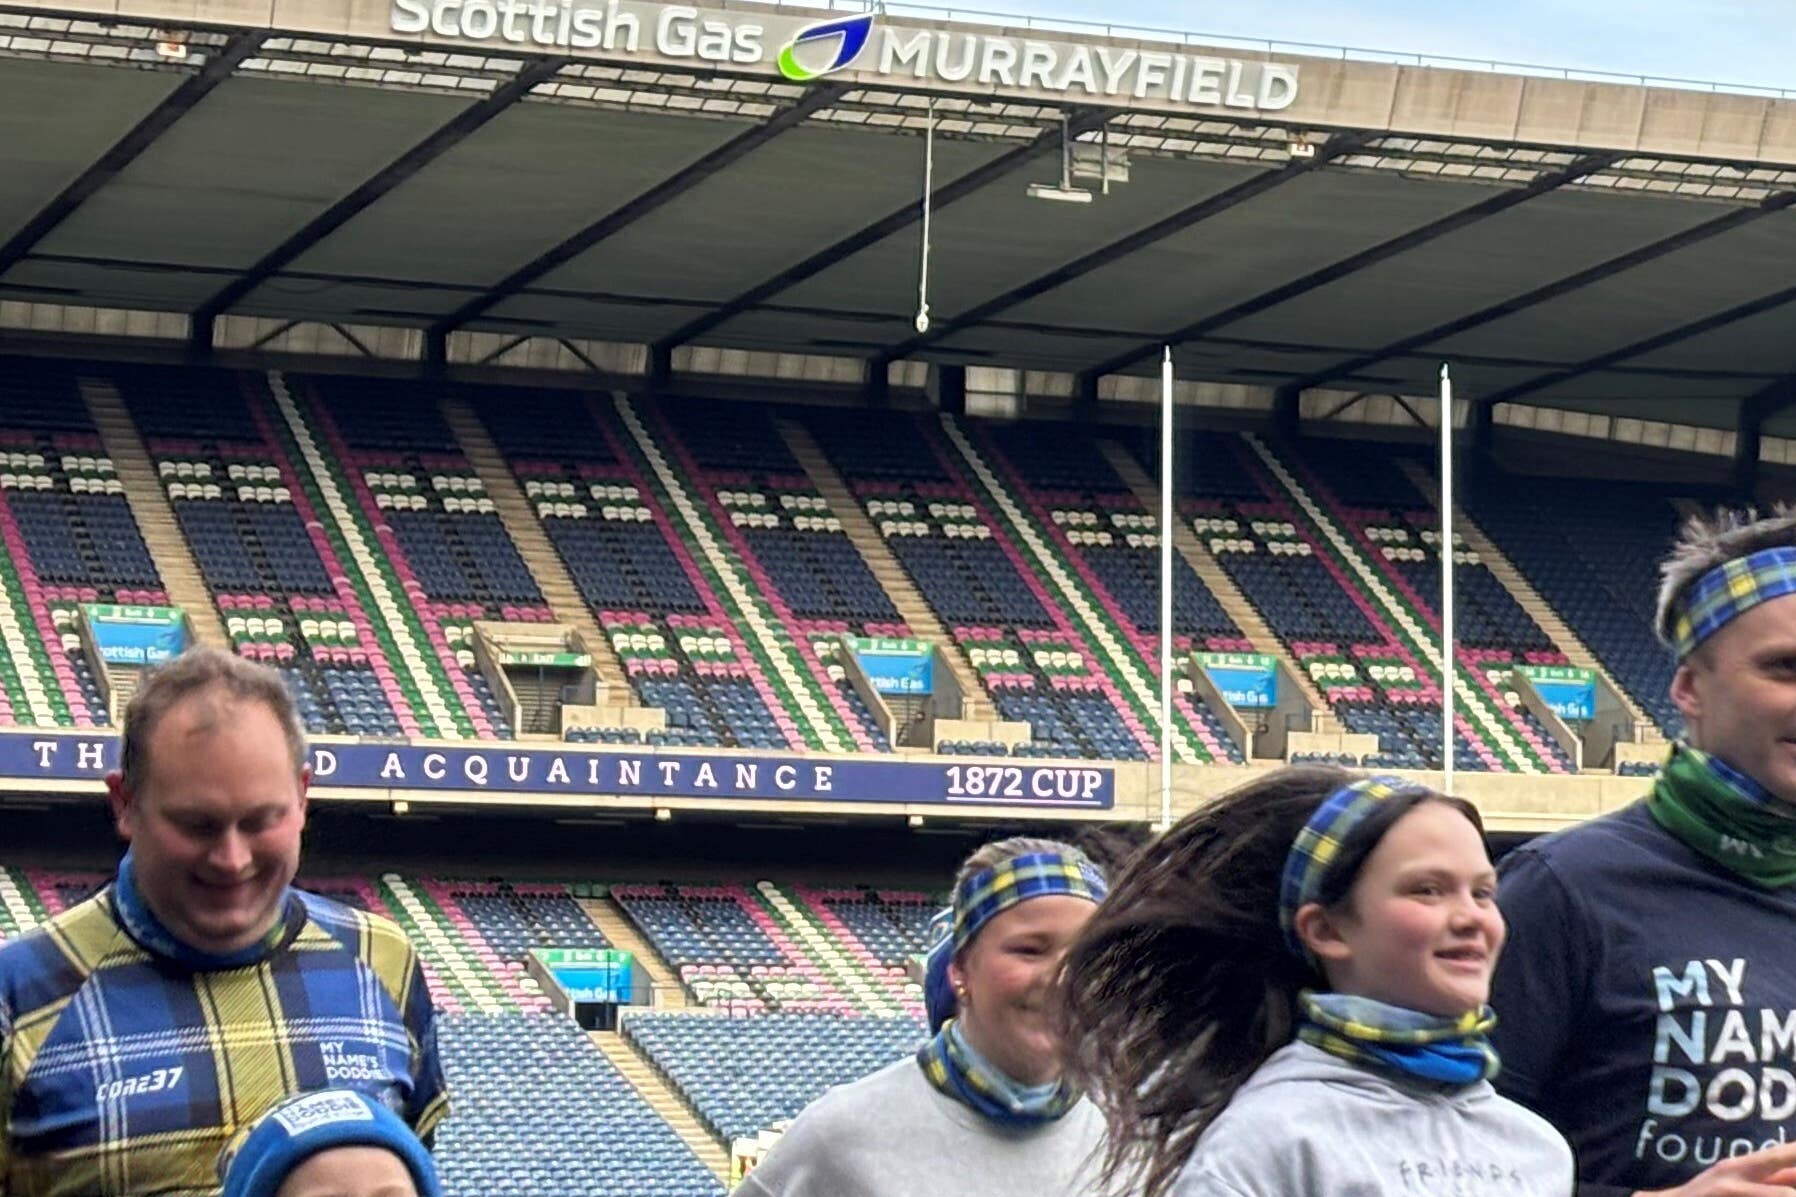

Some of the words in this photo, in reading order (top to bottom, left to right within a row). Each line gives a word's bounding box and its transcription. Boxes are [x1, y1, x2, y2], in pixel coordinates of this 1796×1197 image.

[390, 0, 639, 50] Scottish
[656, 7, 764, 62] Gas
[878, 28, 1299, 110] MURRAYFIELD
[34, 741, 104, 769] TH
[380, 752, 834, 792] ACQUAINTANCE
[946, 766, 1023, 796] 1872
[1032, 768, 1102, 798] CUP
[1652, 958, 1745, 1012] MY
[320, 1041, 344, 1054] MY
